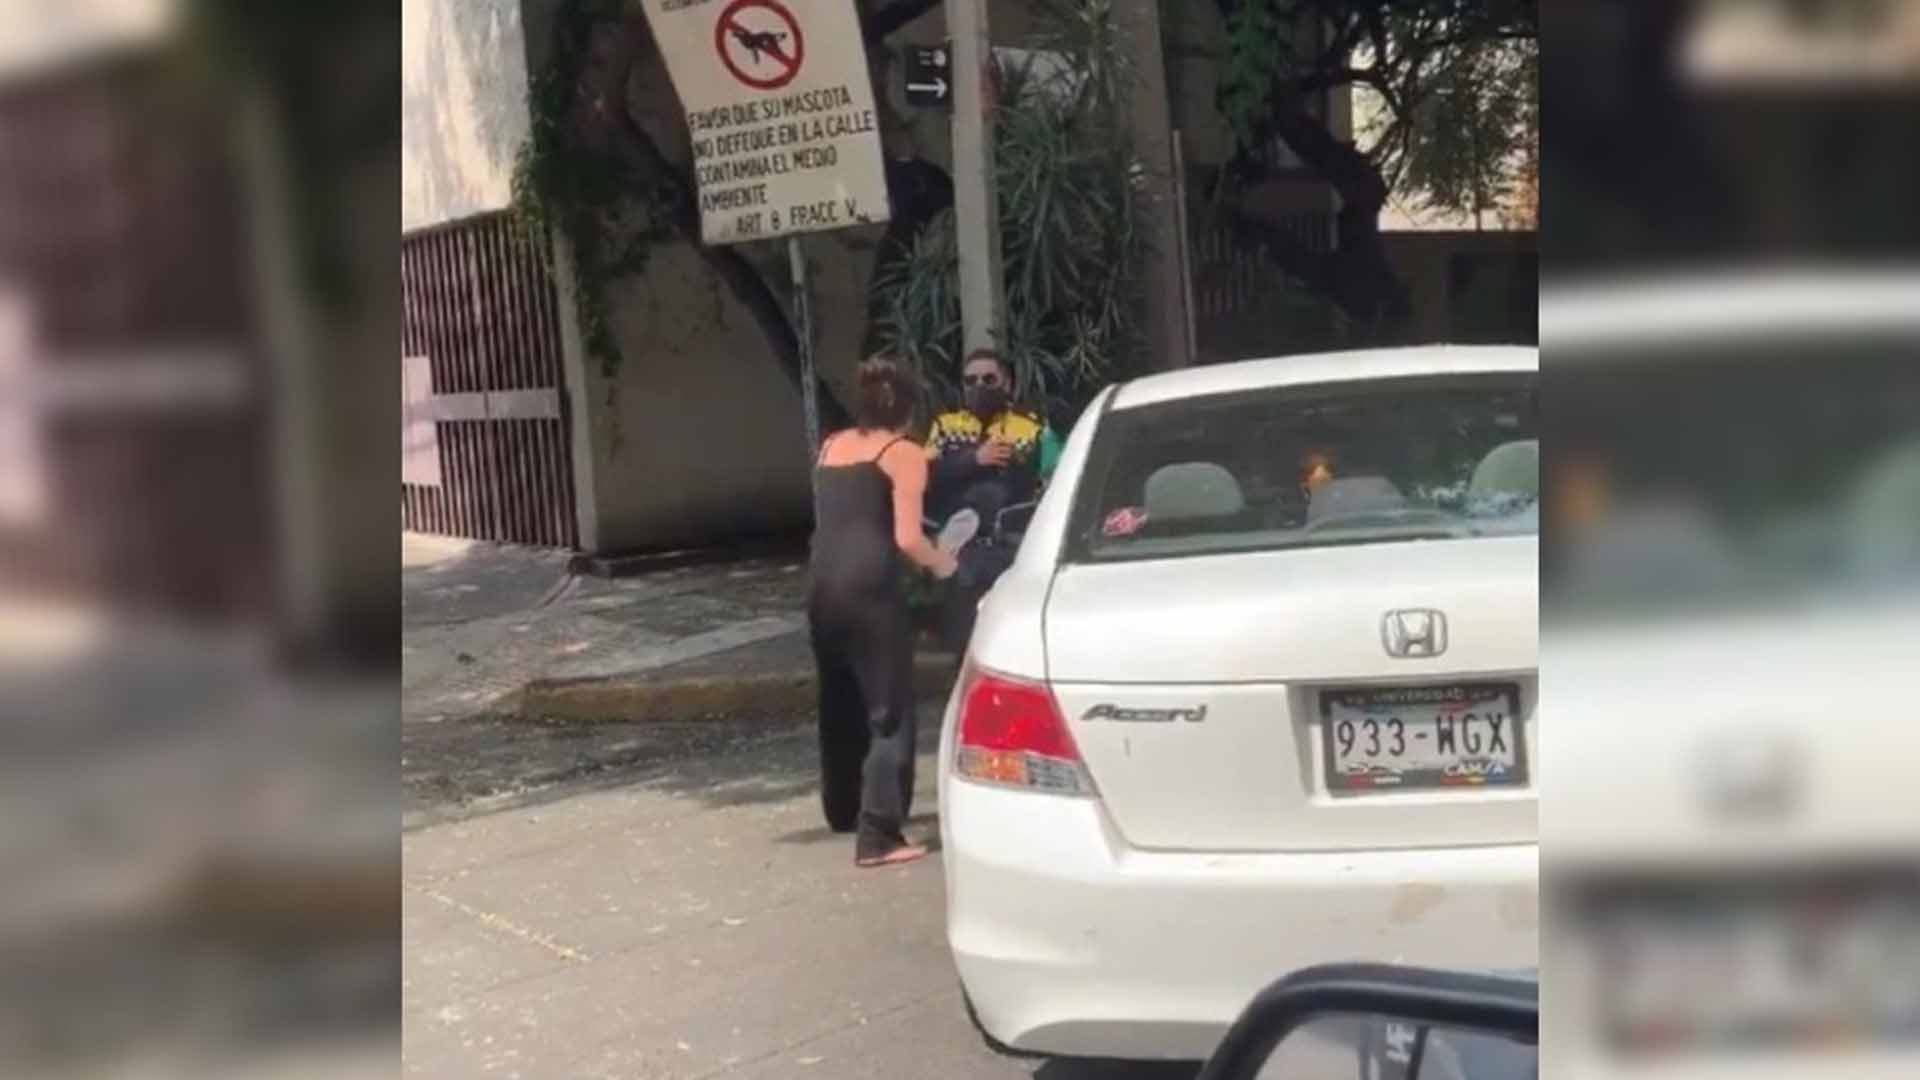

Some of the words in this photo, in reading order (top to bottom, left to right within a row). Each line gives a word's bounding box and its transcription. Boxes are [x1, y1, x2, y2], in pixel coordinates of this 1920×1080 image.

[733, 101, 760, 125] QUE
[763, 98, 781, 118] SU
[783, 85, 852, 115] MASCOTA
[693, 139, 713, 159] NO
[716, 126, 777, 156] DEFEQUE
[779, 123, 798, 144] EN
[801, 119, 824, 142] LA
[825, 110, 874, 138] CALLE
[698, 154, 772, 187] CONTAMINA
[773, 152, 790, 174] EL
[793, 145, 838, 170] MEDIO
[702, 183, 767, 212] AMBIENTE
[1080, 703, 1208, 723] Accord
[1337, 712, 1507, 758] 933-WGX
